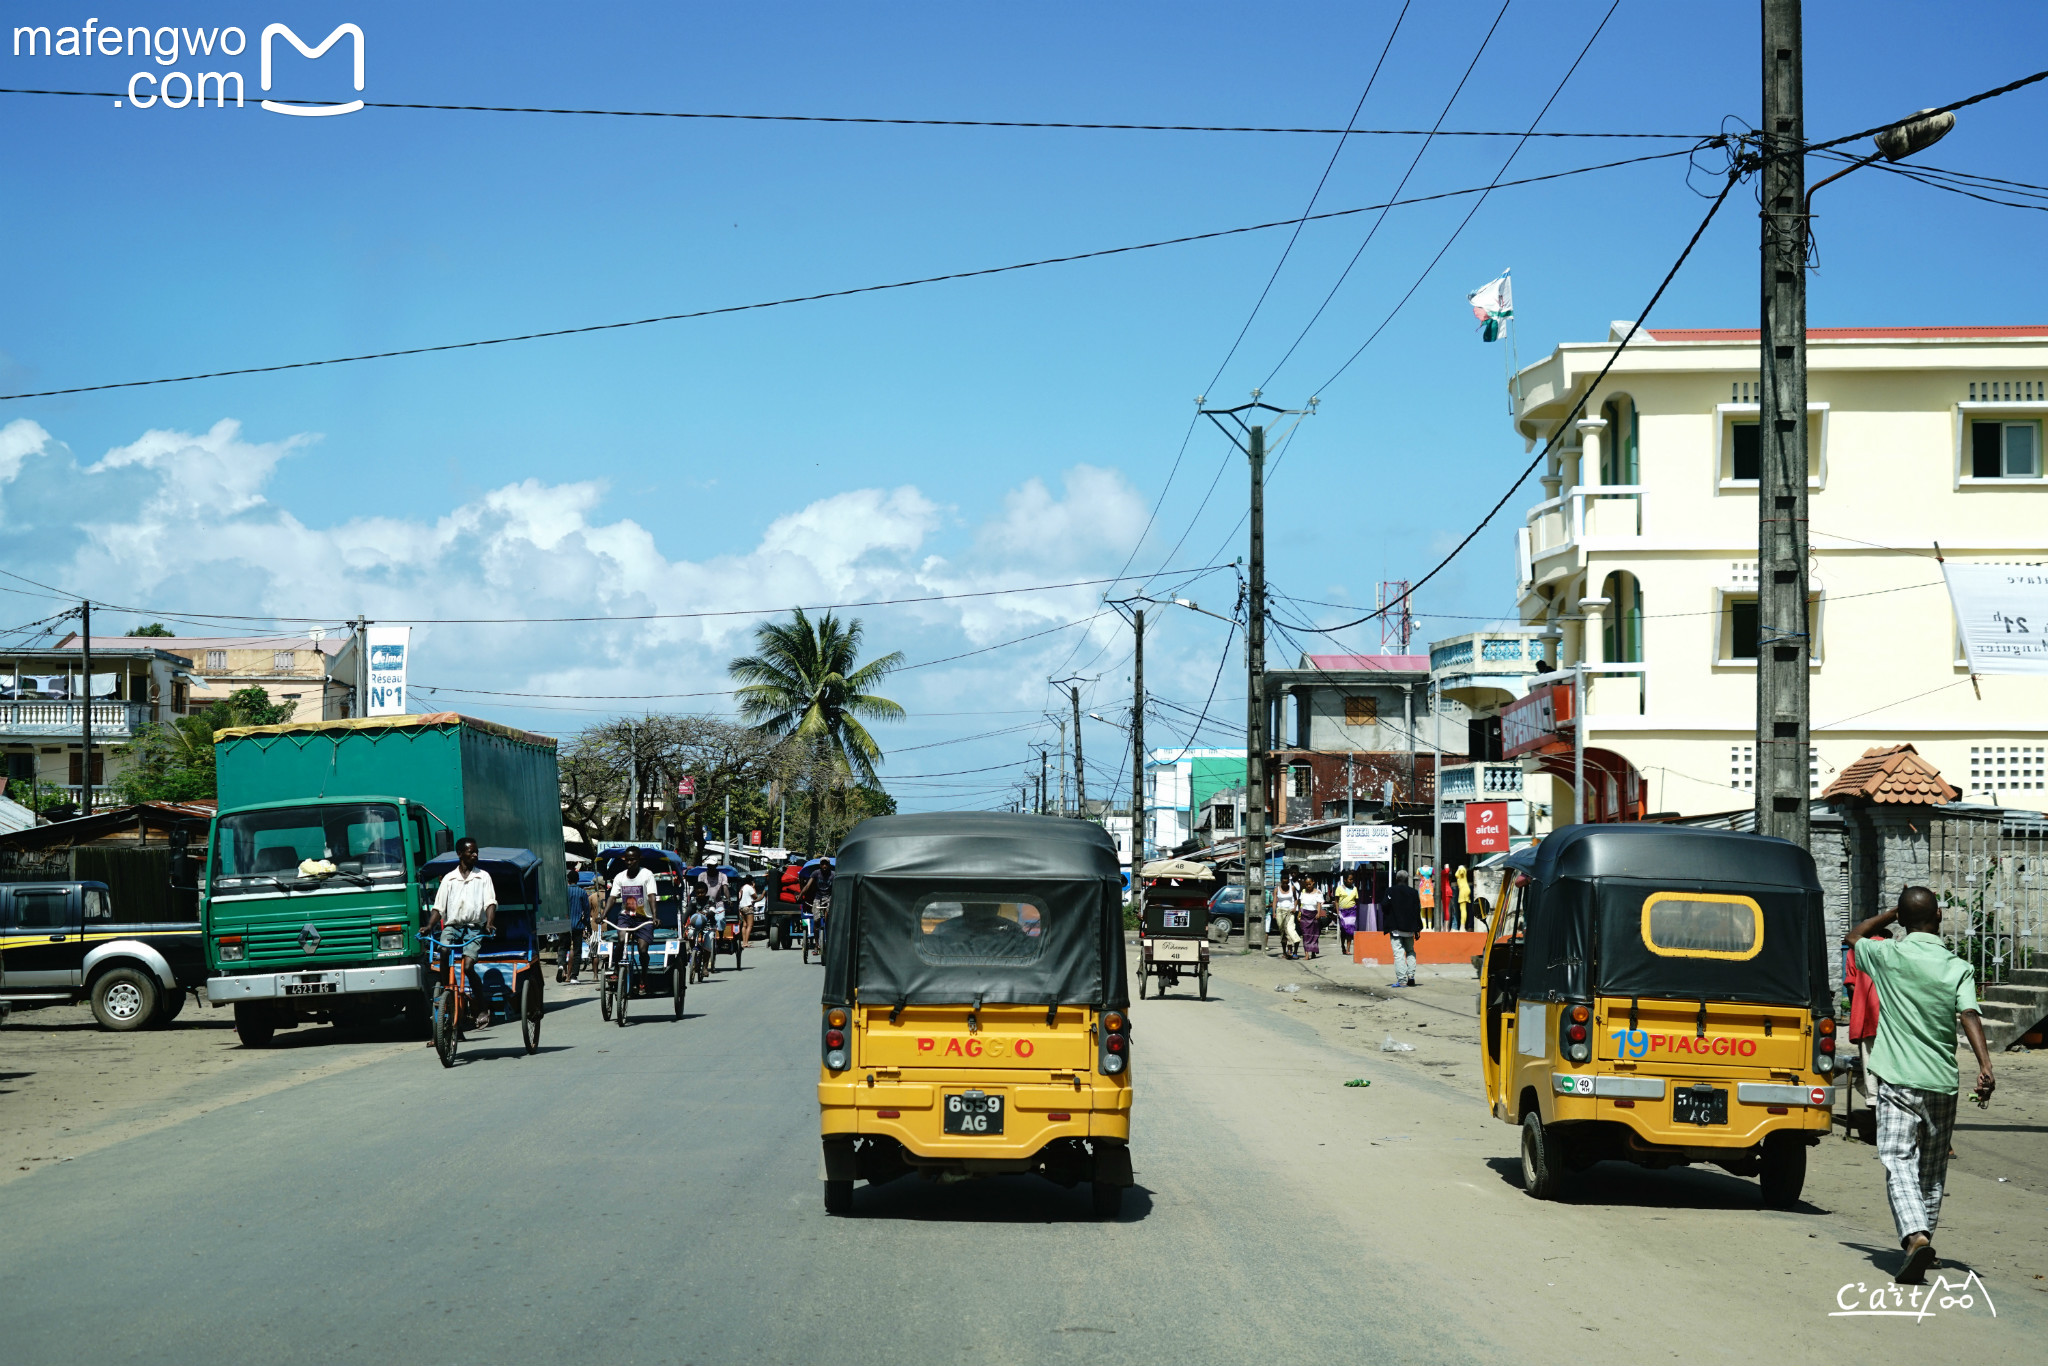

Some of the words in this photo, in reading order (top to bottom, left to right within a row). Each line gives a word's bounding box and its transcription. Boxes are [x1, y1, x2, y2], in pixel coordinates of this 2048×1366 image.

[371, 673, 402, 684] Réseau
[1475, 825, 1499, 834] airtel
[1481, 838, 1494, 846] eto
[292, 984, 313, 994] 4523
[1611, 1029, 1649, 1059] 19
[1649, 1034, 1757, 1057] PIAGGIO
[1579, 1080, 1590, 1088] 40
[1689, 1109, 1711, 1123] AG
[961, 1115, 988, 1131] AG
